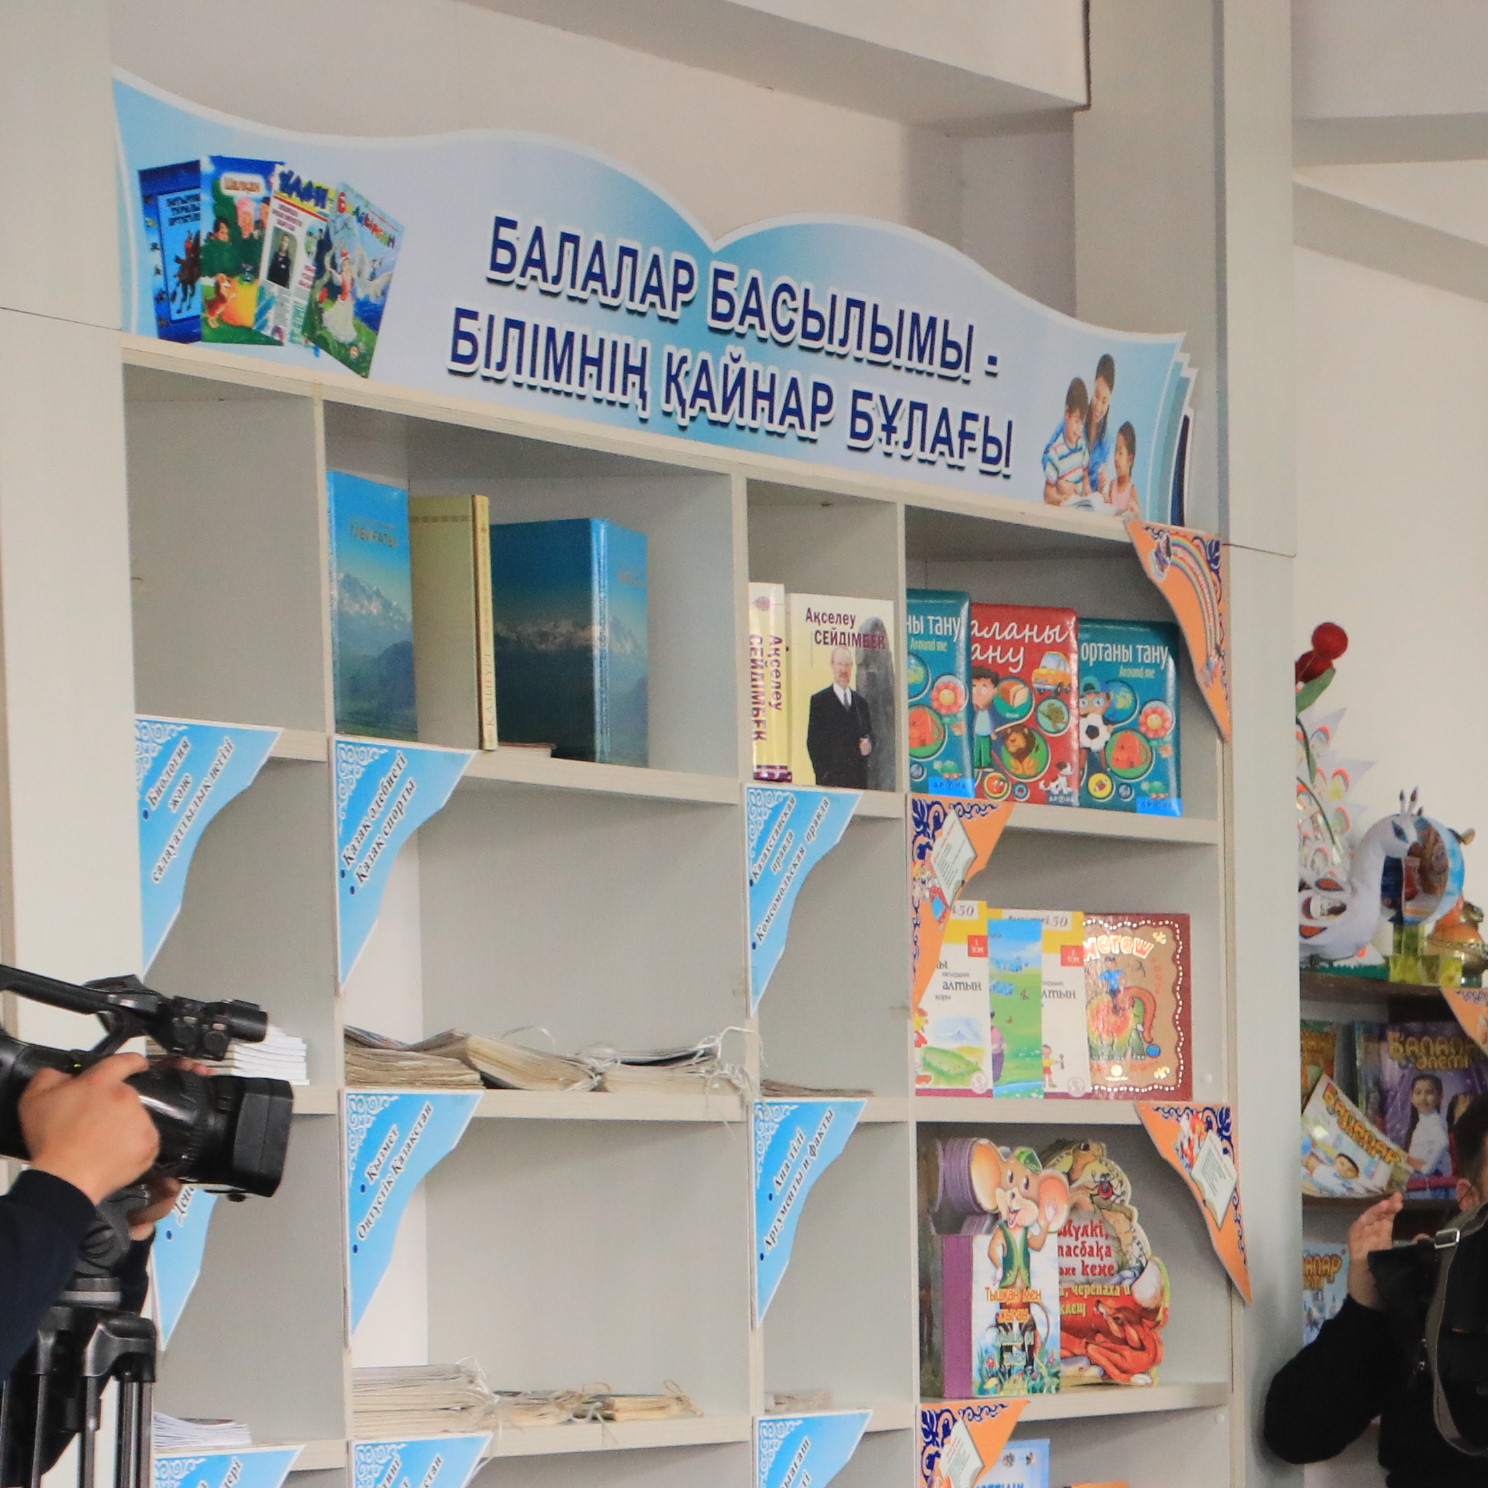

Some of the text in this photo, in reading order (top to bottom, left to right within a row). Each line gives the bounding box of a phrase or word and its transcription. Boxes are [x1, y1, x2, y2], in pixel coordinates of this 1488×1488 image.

[489, 215, 697, 312] БАЛАЛАР
[708, 267, 976, 375] БАСЫЛЫМЫ
[449, 307, 1014, 472] БІЛІМНІҢ ҚАЙНАР БҰЛАҒЫ
[805, 606, 857, 631] Ақселеу
[814, 627, 886, 650] СЕЙДІМБЕК
[927, 614, 961, 642] тану
[971, 619, 1069, 645] аланы
[971, 644, 1025, 673] ану
[1081, 643, 1169, 670] ортаны тану
[147, 738, 191, 808] Биология
[382, 779, 417, 837] спорты
[752, 797, 796, 881] Казахстанская
[771, 830, 795, 874] правда
[757, 798, 830, 943] Комсомольская правда
[765, 1172, 803, 1252] Аргументы
[809, 1108, 834, 1159] факты
[774, 1129, 804, 1195] Ана тілі
